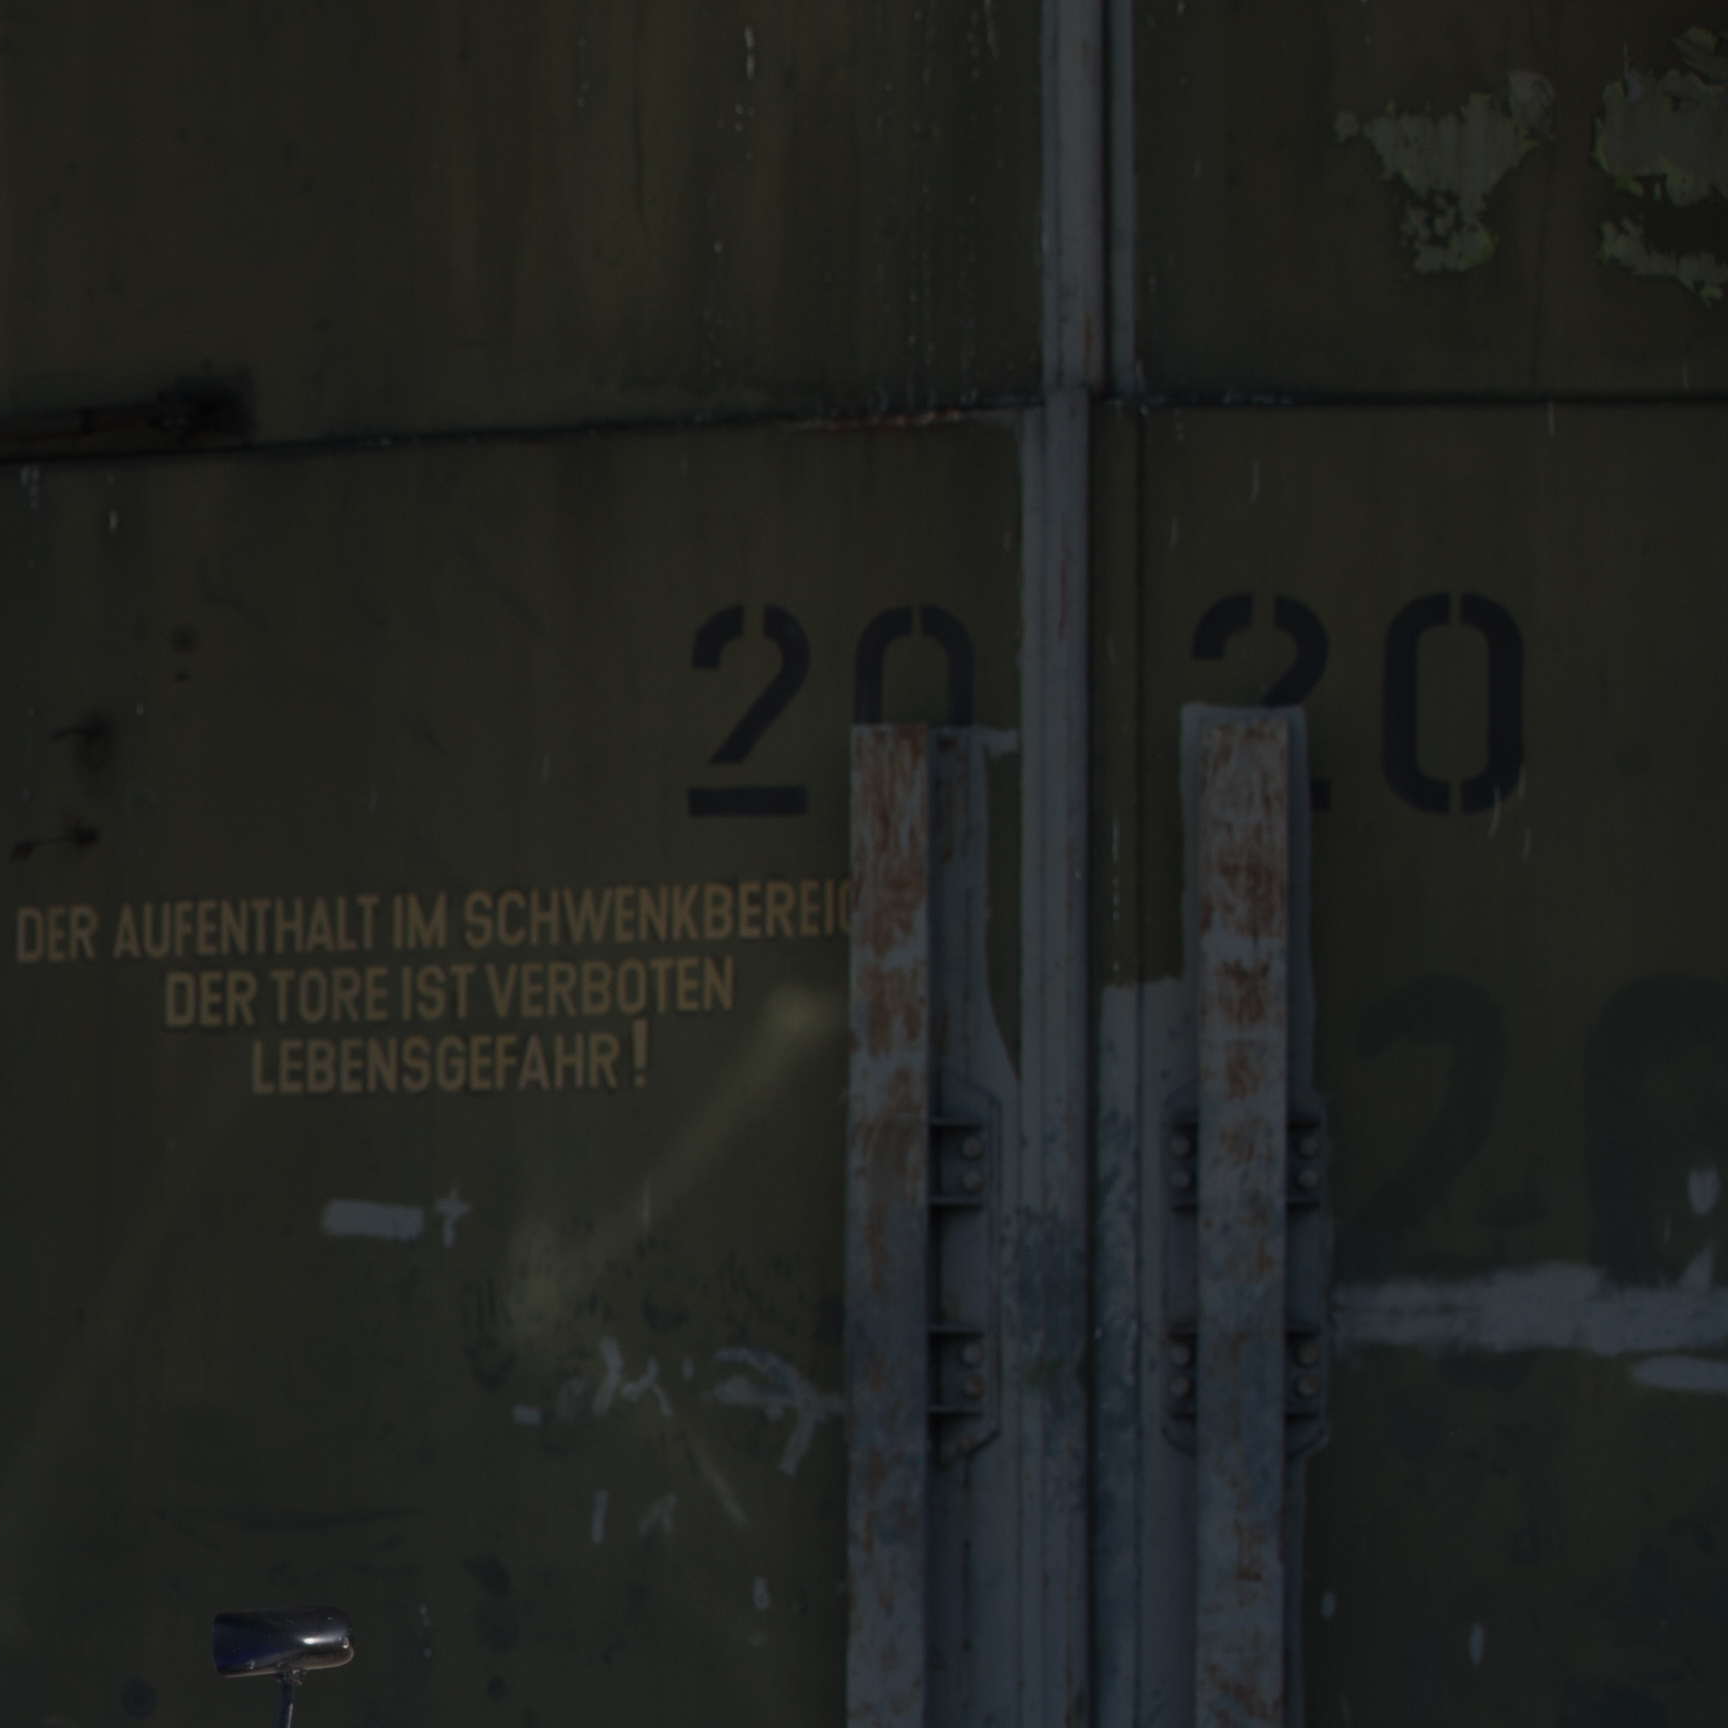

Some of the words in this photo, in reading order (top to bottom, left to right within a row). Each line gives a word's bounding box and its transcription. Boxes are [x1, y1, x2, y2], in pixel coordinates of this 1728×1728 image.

[16, 904, 101, 964] DER
[113, 895, 379, 960] AUFENTHALT
[393, 893, 448, 951] IM
[164, 970, 256, 1027] DER
[270, 965, 389, 1024] TORE
[401, 963, 476, 1021] IST
[486, 955, 735, 1018] VERBOTEN
